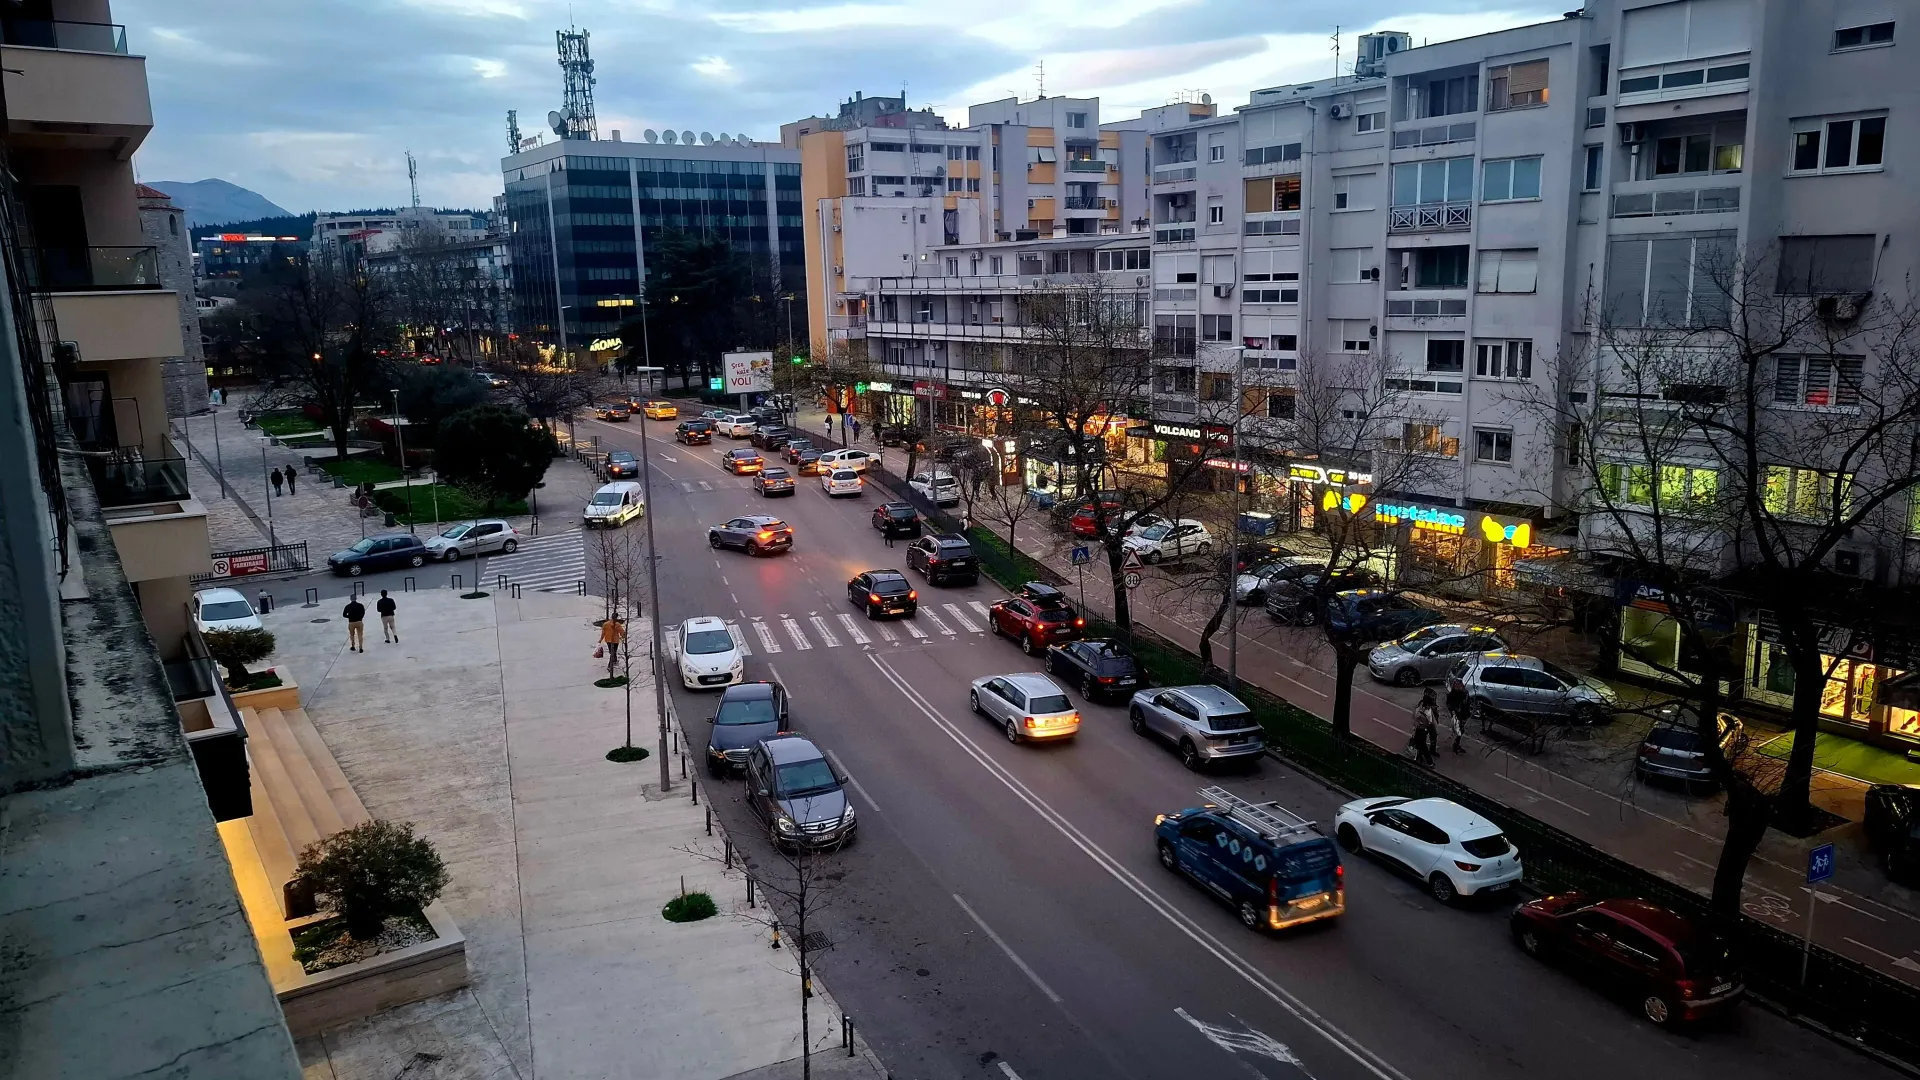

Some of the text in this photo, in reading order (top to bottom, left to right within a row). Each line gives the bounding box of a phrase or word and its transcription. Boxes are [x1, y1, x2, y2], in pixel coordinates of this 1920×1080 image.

[590, 337, 622, 351] AROMA
[731, 377, 751, 386] VOLI
[1154, 424, 1201, 439] VOLCANO
[1376, 503, 1465, 527] metalac
[1415, 520, 1465, 535] MARKET
[1126, 575, 1138, 585] 30
